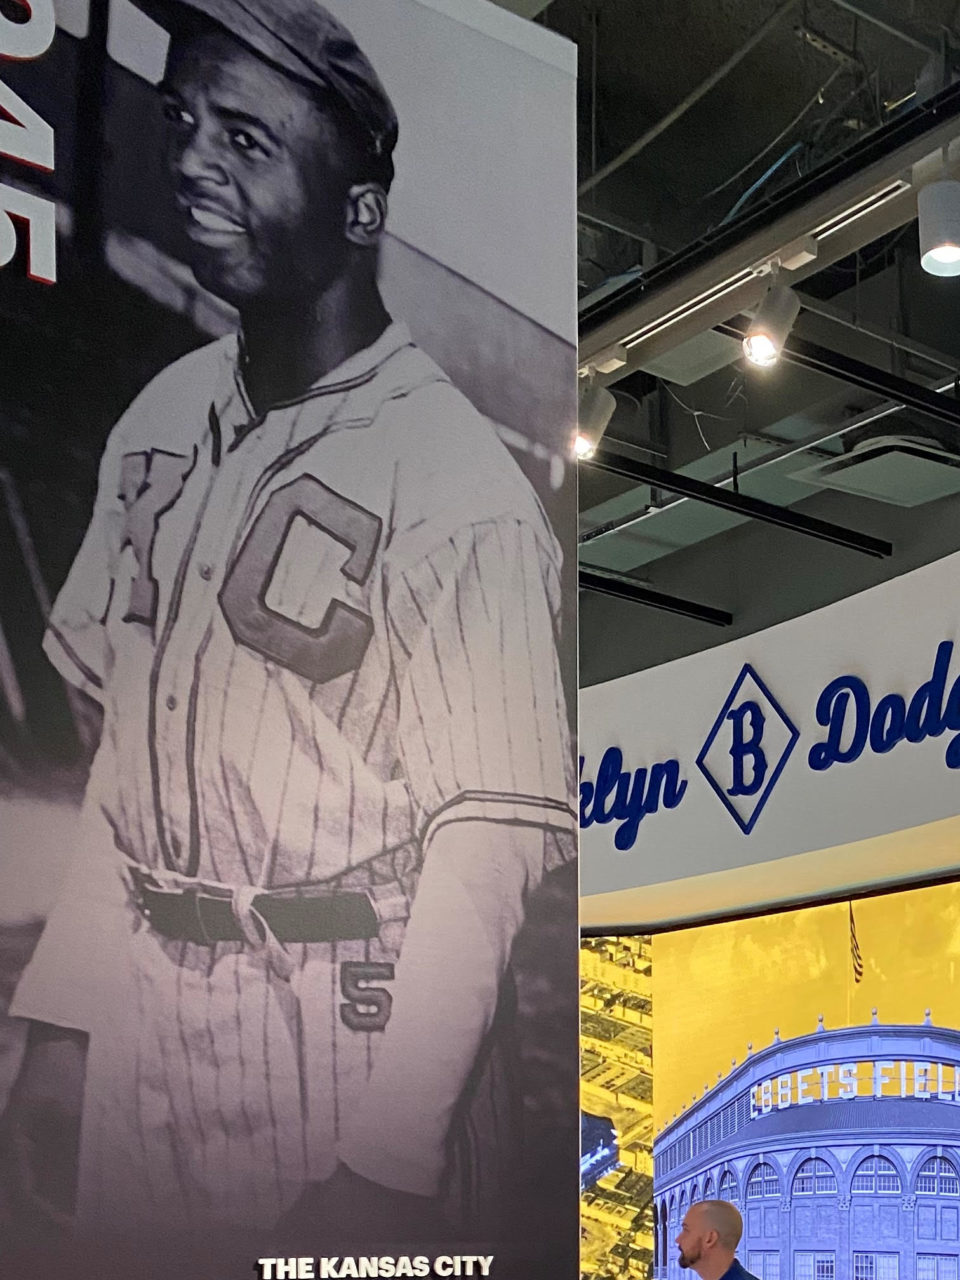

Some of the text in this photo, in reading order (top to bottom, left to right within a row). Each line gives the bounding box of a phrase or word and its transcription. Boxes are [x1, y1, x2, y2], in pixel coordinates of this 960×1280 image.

[217, 473, 382, 685] C
[727, 701, 768, 796] B
[339, 960, 396, 1034] 5
[750, 1062, 857, 1119] EBBETS
[258, 1255, 494, 1280] THE KANSAS CITY
